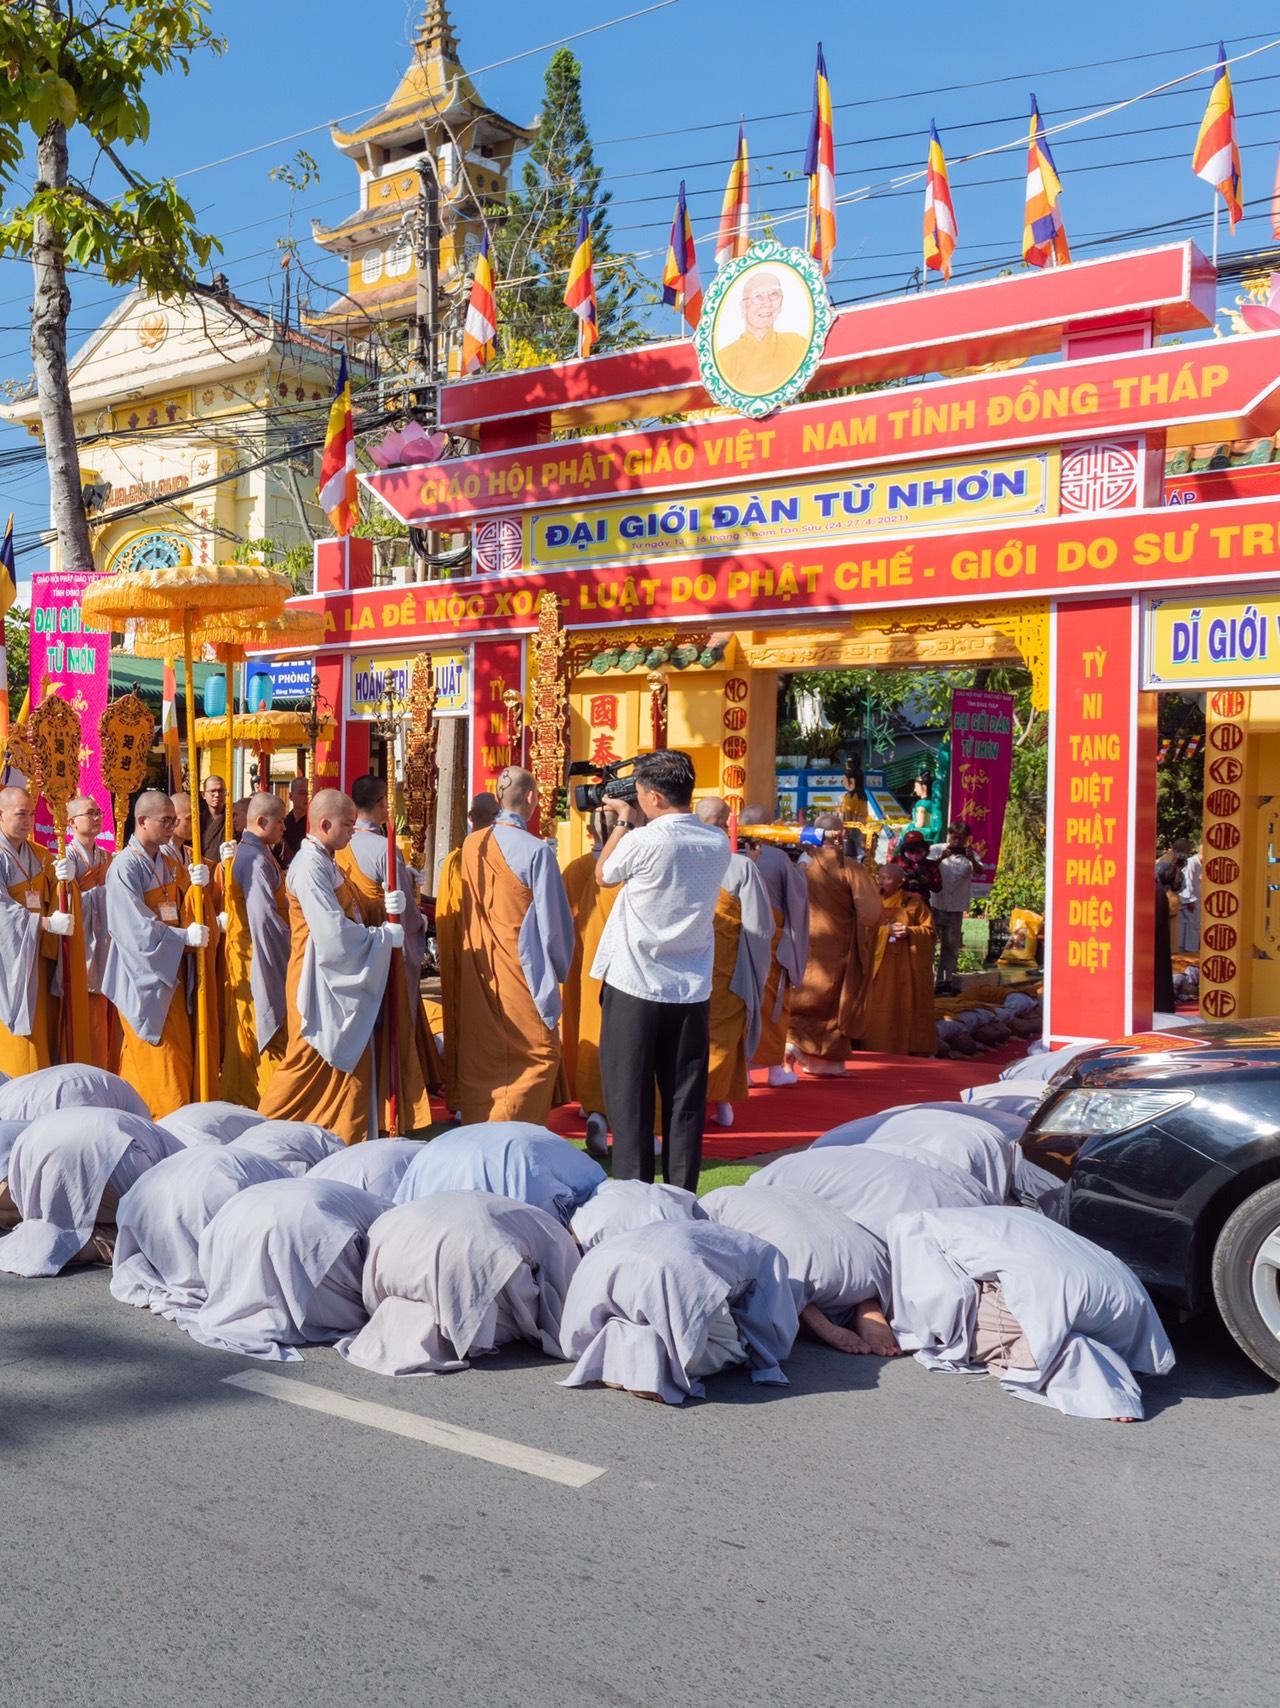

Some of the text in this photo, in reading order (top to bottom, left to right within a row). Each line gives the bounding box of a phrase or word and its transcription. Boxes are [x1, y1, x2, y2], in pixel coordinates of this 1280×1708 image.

[421, 362, 1229, 505] GIÁO HỘI PHẬT GIÁO VIỆT NAM TỈNH ĐỒNG THÁP
[545, 470, 1026, 549] ĐẠI GIỚI ĐÀN TỪ NHƠN
[1163, 489, 1197, 506] ÁP
[344, 605, 375, 631] LA
[382, 593, 417, 628] ĐỀ
[425, 592, 484, 627] MỘC
[580, 575, 662, 612] LUẬT
[672, 574, 717, 603] DO
[727, 562, 823, 601] PHẬT
[834, 544, 915, 590] CHẾ
[951, 539, 1037, 581] GIỚI
[1057, 537, 1118, 572] DO
[1132, 523, 1200, 565] SƯ
[1209, 520, 1280, 559] TR
[34, 607, 56, 640] ĐẠI
[1172, 605, 1268, 663] DĨ GIỚI
[278, 672, 310, 684] PHÒNG
[435, 658, 463, 704] LUẬT
[490, 675, 505, 701] TỲ
[491, 713, 503, 734] NI
[1066, 646, 1120, 973] TỲ NI TẠNG DIỆT PHẬT PHÁP DIỆC DIỆT
